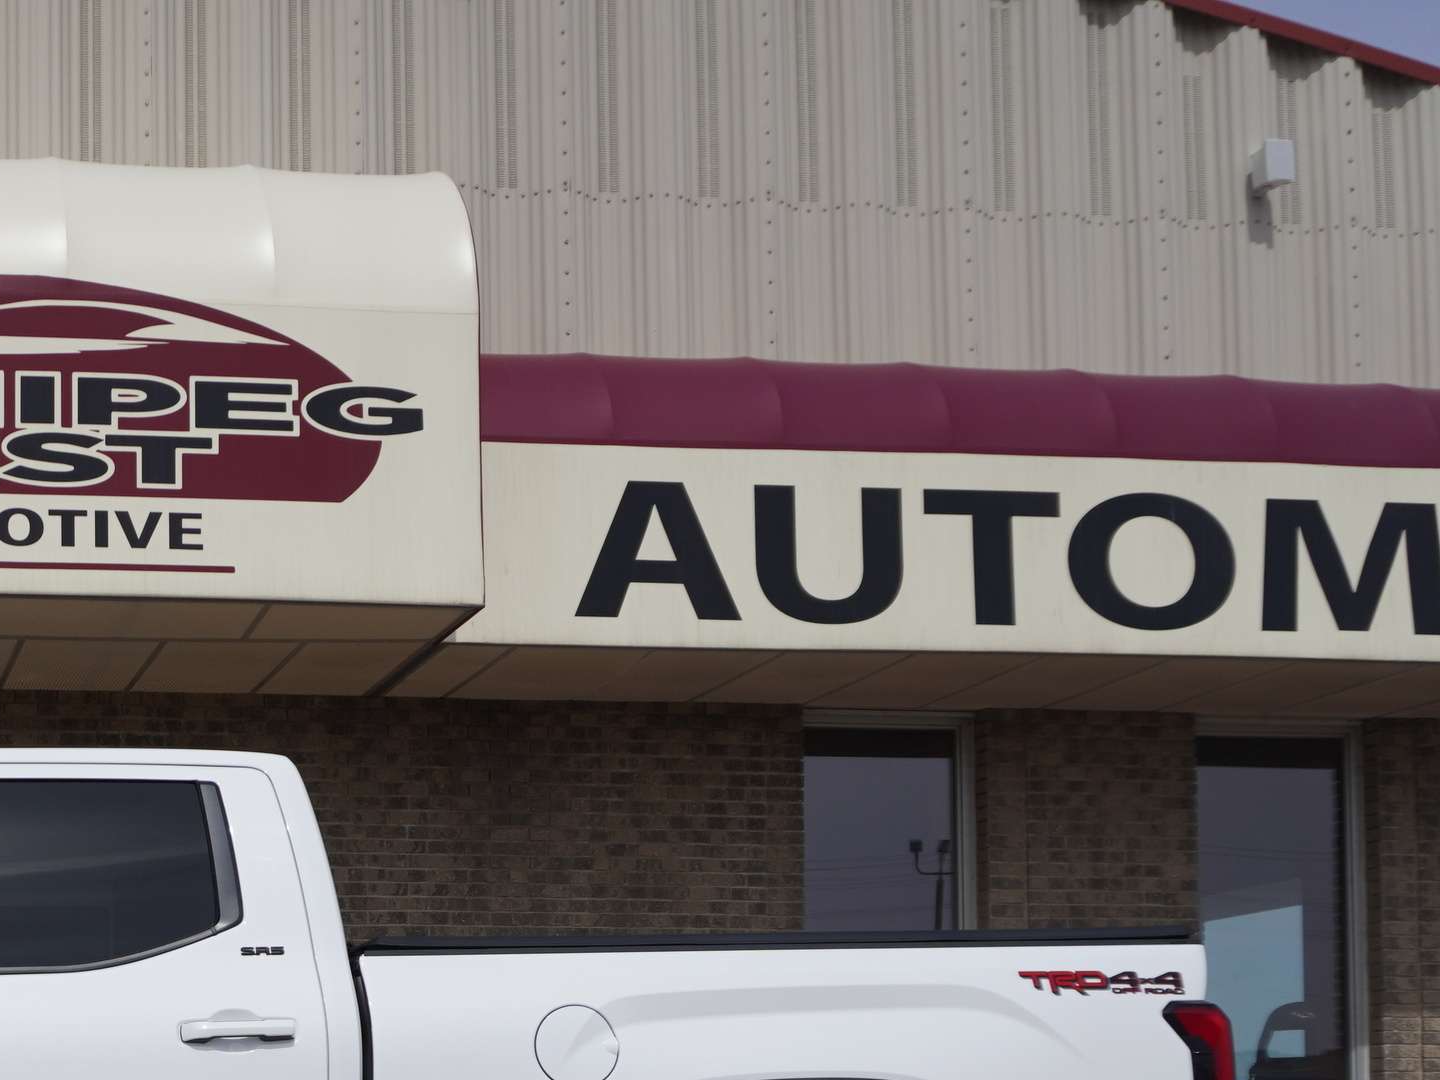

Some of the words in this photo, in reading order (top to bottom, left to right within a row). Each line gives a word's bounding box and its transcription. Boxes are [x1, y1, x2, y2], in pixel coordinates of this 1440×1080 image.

[574, 480, 1440, 636] AUTOM
[240, 946, 285, 956] SR5
[1018, 970, 1109, 996] TRD
